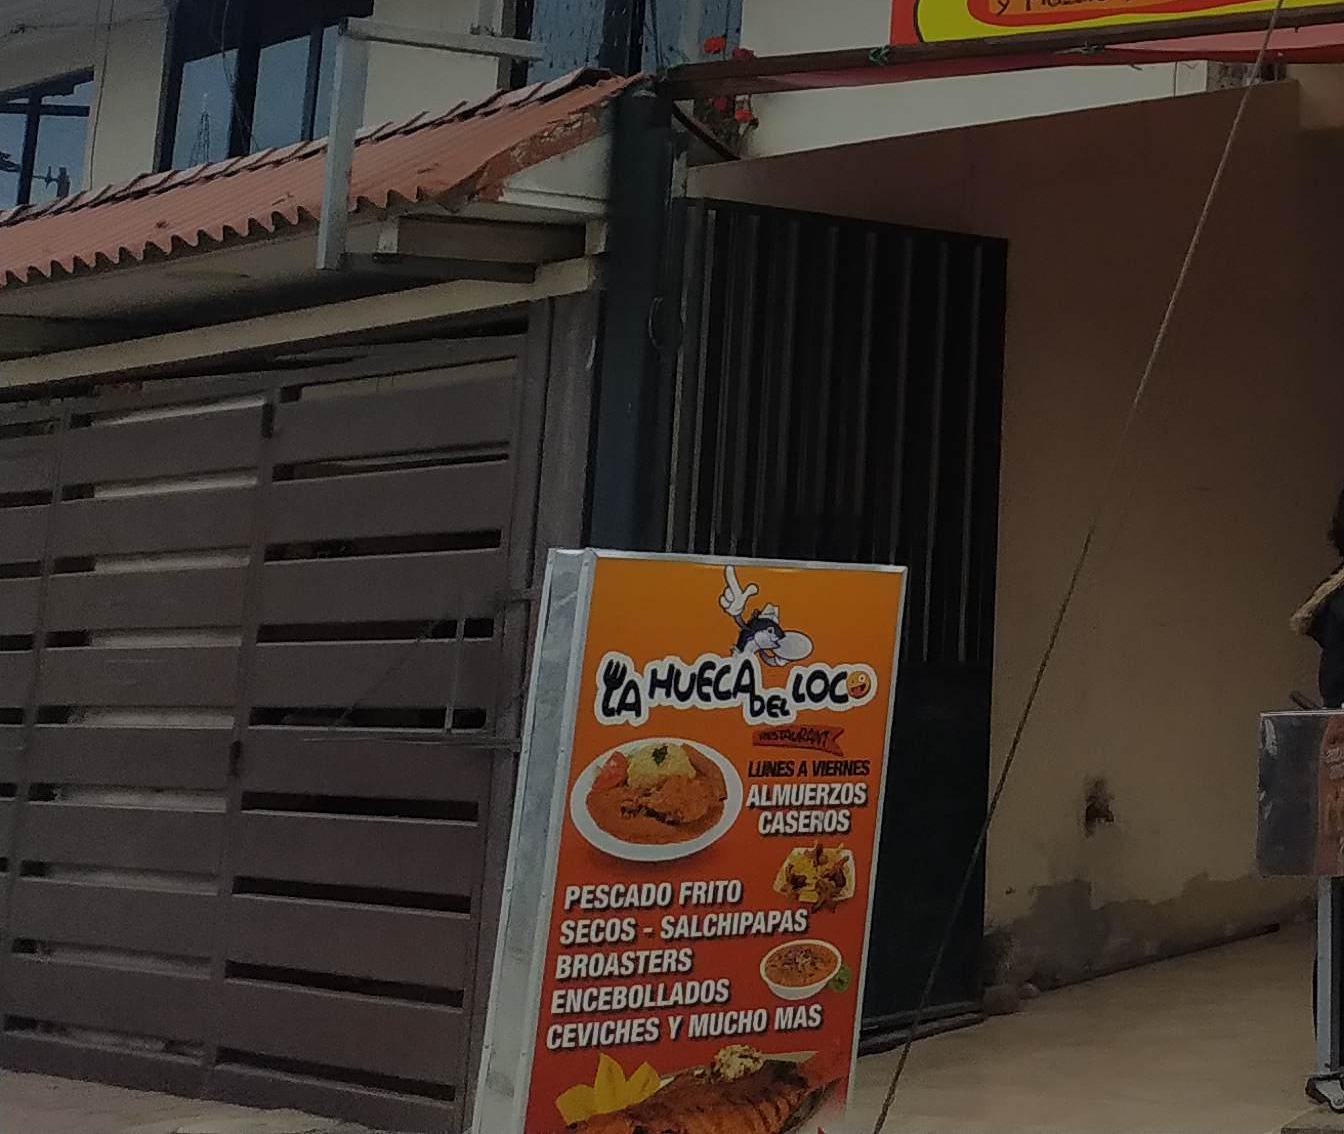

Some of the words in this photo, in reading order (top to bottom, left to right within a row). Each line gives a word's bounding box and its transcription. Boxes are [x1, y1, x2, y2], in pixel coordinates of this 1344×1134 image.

[600, 659, 643, 720] LA
[648, 660, 755, 706] HUECA
[749, 695, 791, 719] DEL
[748, 760, 795, 778] LUNES
[797, 760, 808, 778] A
[812, 759, 871, 778] VIERNES
[745, 782, 868, 808] ALMUERZOS
[757, 810, 852, 836] CASEROS
[563, 880, 673, 912] PESCADO
[678, 879, 744, 906] FRITO
[559, 916, 637, 946] SECOS
[659, 908, 810, 940] SALCHIPAPAS
[555, 948, 694, 980] BROASTERS
[550, 978, 731, 1015] ENCEBOLLADOS
[546, 1016, 660, 1052] CEVICHES
[667, 1015, 683, 1041] Y
[687, 1008, 769, 1038] MUCHO
[773, 1003, 824, 1032] MAS
